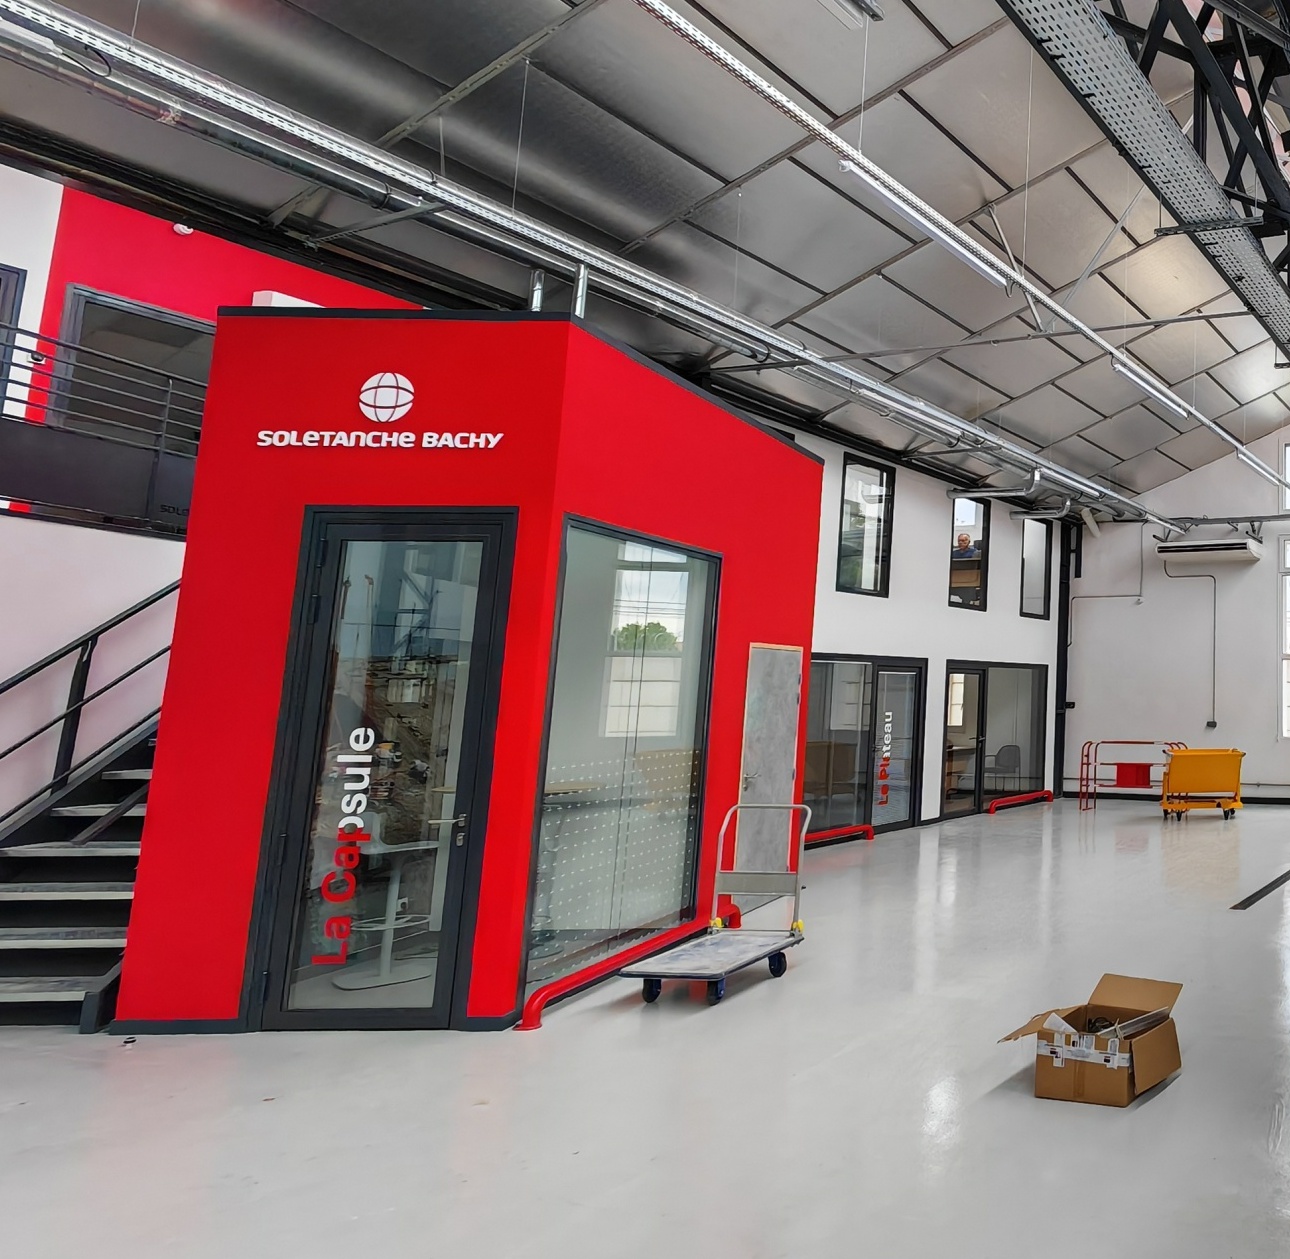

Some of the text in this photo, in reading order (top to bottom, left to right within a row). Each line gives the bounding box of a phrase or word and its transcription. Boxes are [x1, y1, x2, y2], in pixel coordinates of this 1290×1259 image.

[421, 432, 505, 449] BACHY
[310, 726, 376, 966] La Capsule
